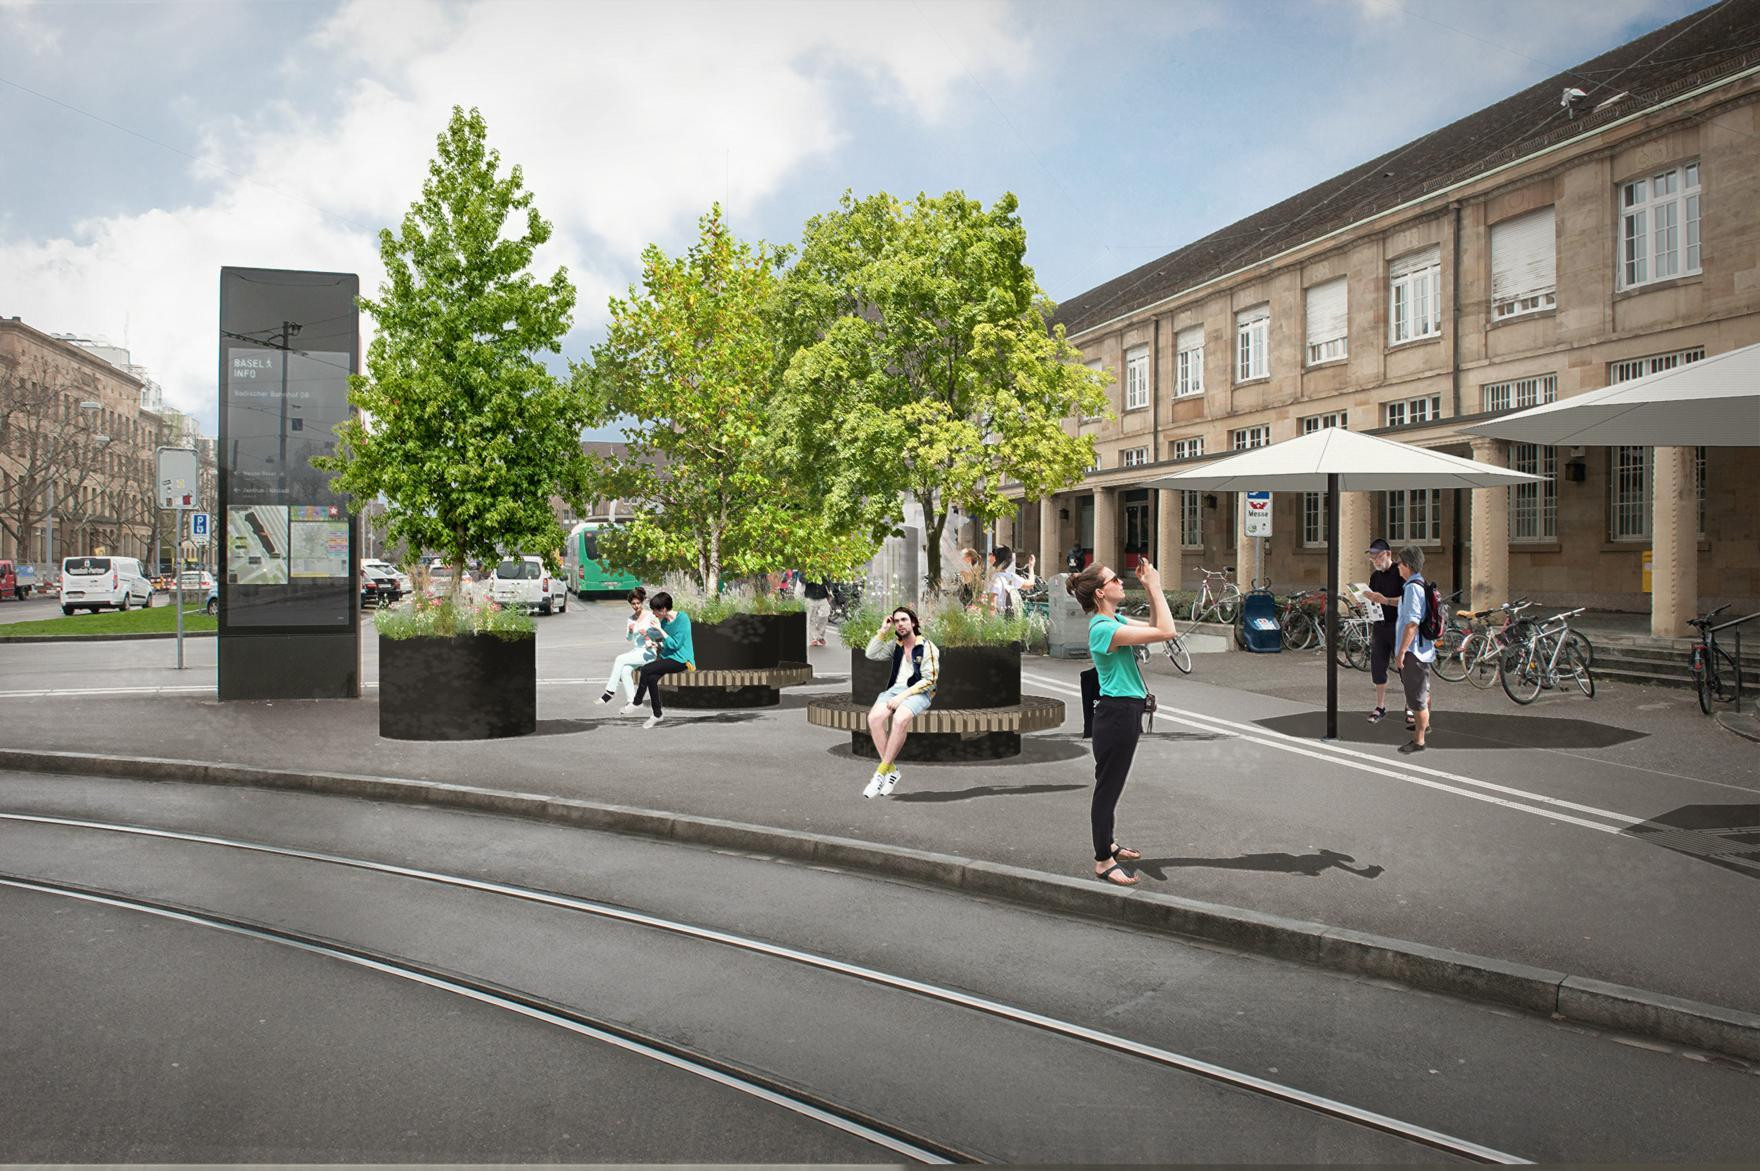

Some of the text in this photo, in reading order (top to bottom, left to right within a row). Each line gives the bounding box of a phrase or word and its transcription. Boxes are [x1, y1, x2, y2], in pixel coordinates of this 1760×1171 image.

[233, 358, 264, 368] BASEL
[233, 369, 256, 378] INFO
[197, 516, 204, 525] P
